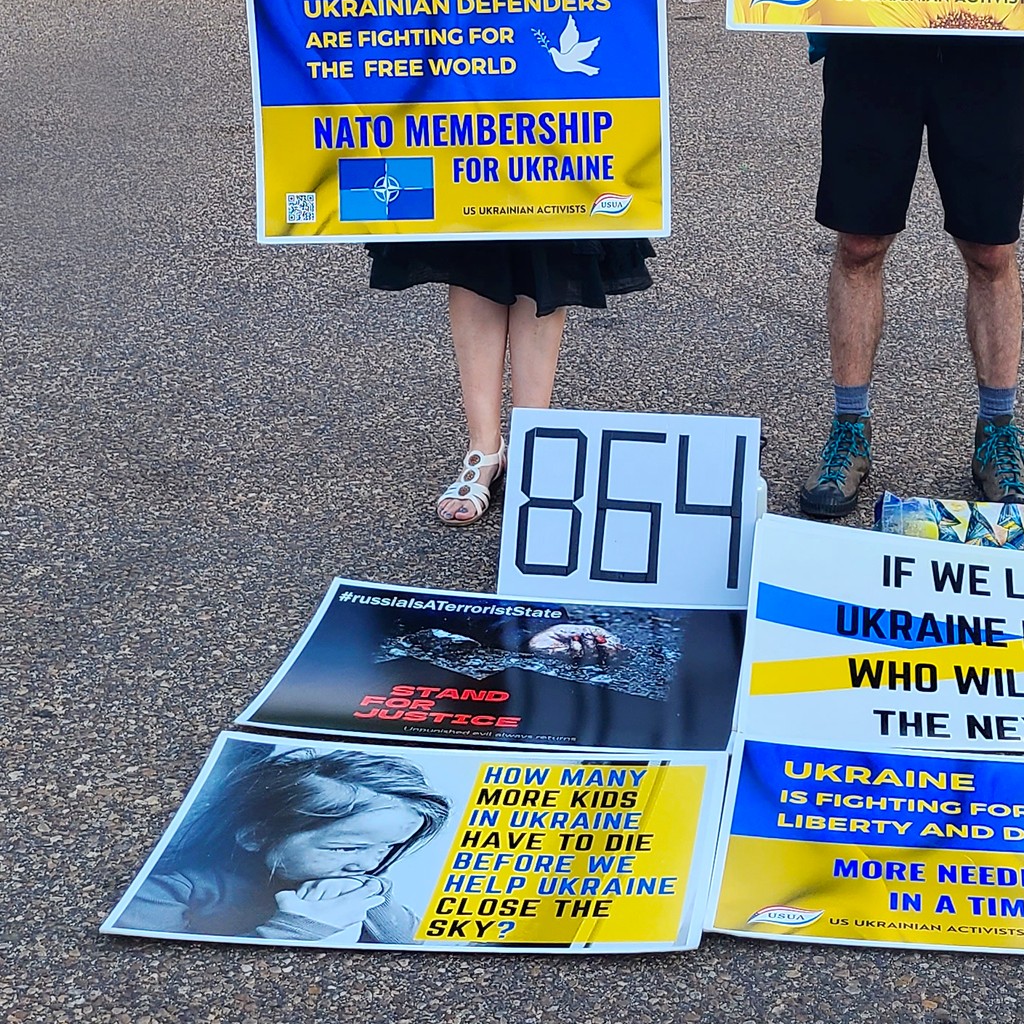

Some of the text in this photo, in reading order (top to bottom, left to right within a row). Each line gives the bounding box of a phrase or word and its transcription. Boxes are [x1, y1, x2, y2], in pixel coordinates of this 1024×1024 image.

[305, 27, 515, 49] ARE FIGHTING FOR
[307, 59, 517, 79] THE FREE WORLD
[314, 112, 613, 150] NATO MEMBERSHIP
[453, 155, 614, 183] FOR UKRAINE
[463, 205, 586, 216] US UKRAINIAN ACTIVISTS
[600, 201, 623, 209] USUA
[515, 427, 747, 589] 864
[882, 555, 916, 589] IF
[930, 560, 992, 597] WE
[836, 604, 1009, 649] UKRAINE
[848, 657, 938, 693] WHO
[358, 697, 436, 711] FOR
[389, 685, 511, 702] STAND
[353, 708, 522, 728] JUSTICE
[873, 709, 951, 739] THE
[404, 726, 470, 736] Unpunished
[495, 733, 532, 741] always
[484, 766, 647, 787] HOW MANY
[783, 760, 977, 792] UKRAINE
[476, 788, 638, 808] MORE KIDS
[779, 790, 812, 806] IS
[815, 792, 963, 815] FIGHTING
[469, 809, 642, 830] IN UKRAINE
[777, 813, 912, 836] LIBERTY
[920, 822, 994, 841] AND
[460, 830, 654, 852] HAVE TO DIE
[452, 852, 637, 874] BEFORE WE
[833, 858, 927, 881] MORE
[444, 875, 677, 895] HELP UKRAINE
[435, 897, 613, 917] CLOSE THE
[889, 892, 923, 913] IN
[933, 895, 956, 913] A
[426, 919, 515, 939] SKY?
[854, 920, 942, 931] UKRAINIAN
[947, 926, 1024, 935] ACTIVISTS
